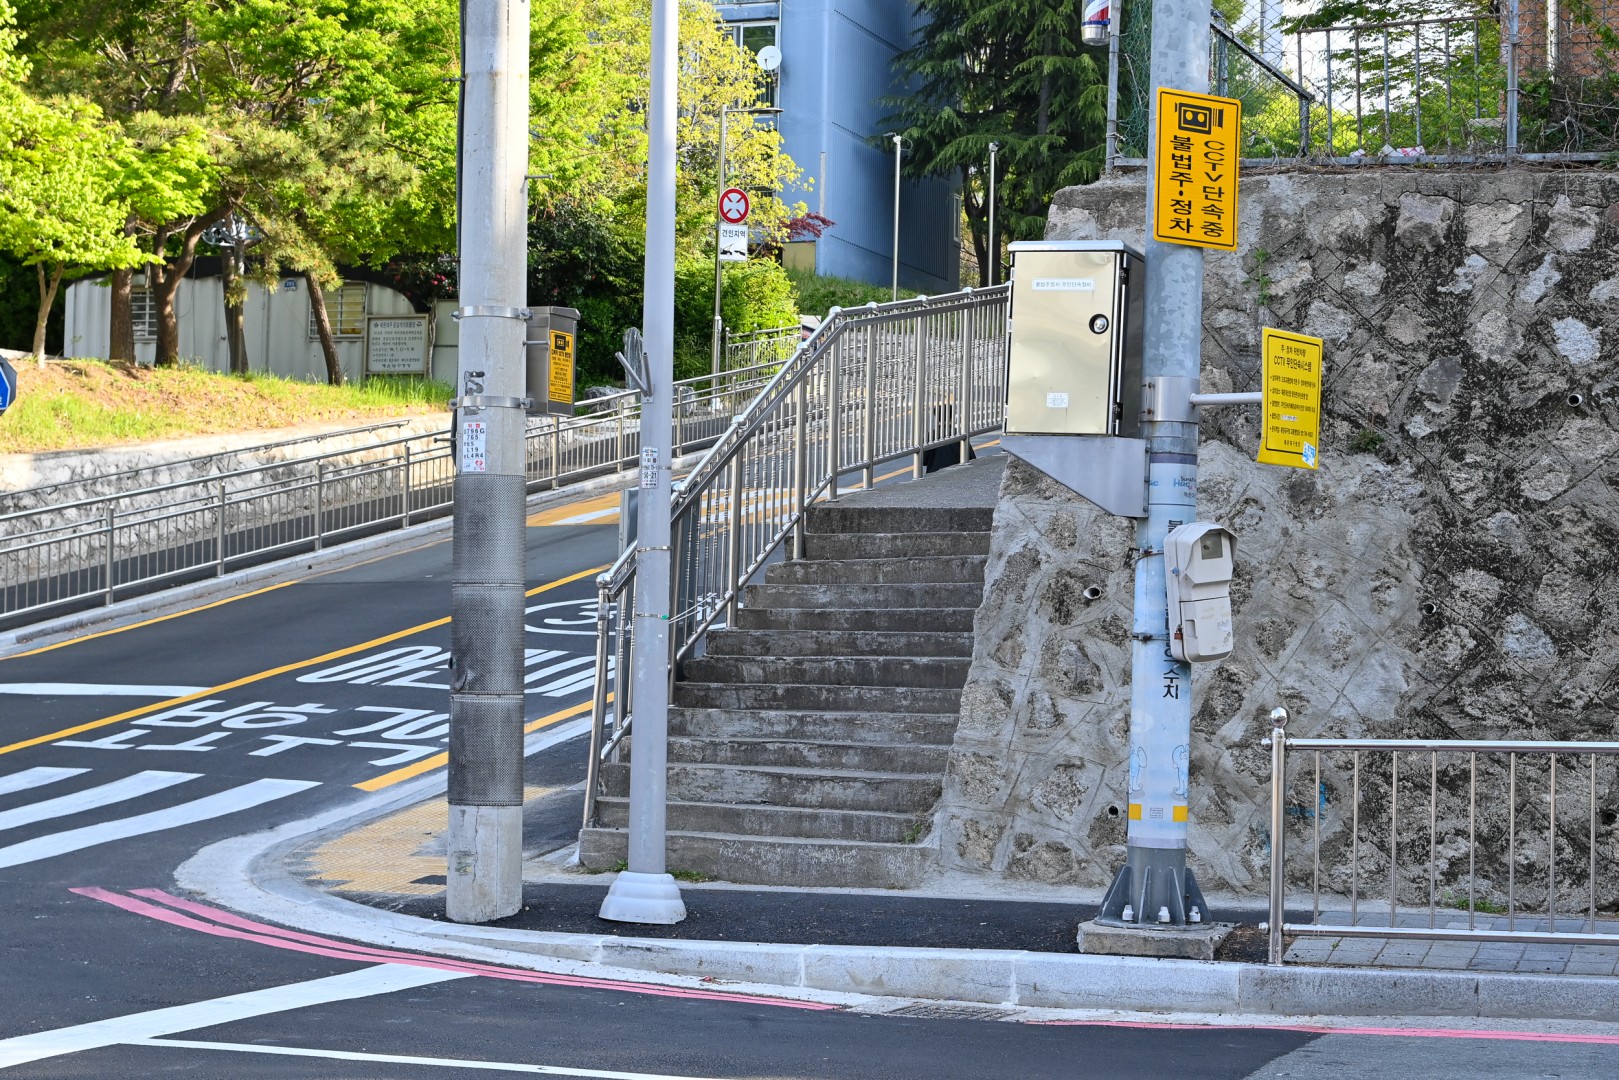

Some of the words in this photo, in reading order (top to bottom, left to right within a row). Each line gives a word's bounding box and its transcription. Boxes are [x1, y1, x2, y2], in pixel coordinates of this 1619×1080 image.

[722, 229, 746, 238] 견인지역
[1273, 355, 1286, 367] CCTV
[1286, 357, 1312, 373] 무인단속시스템
[1162, 668, 1180, 700] 수치
